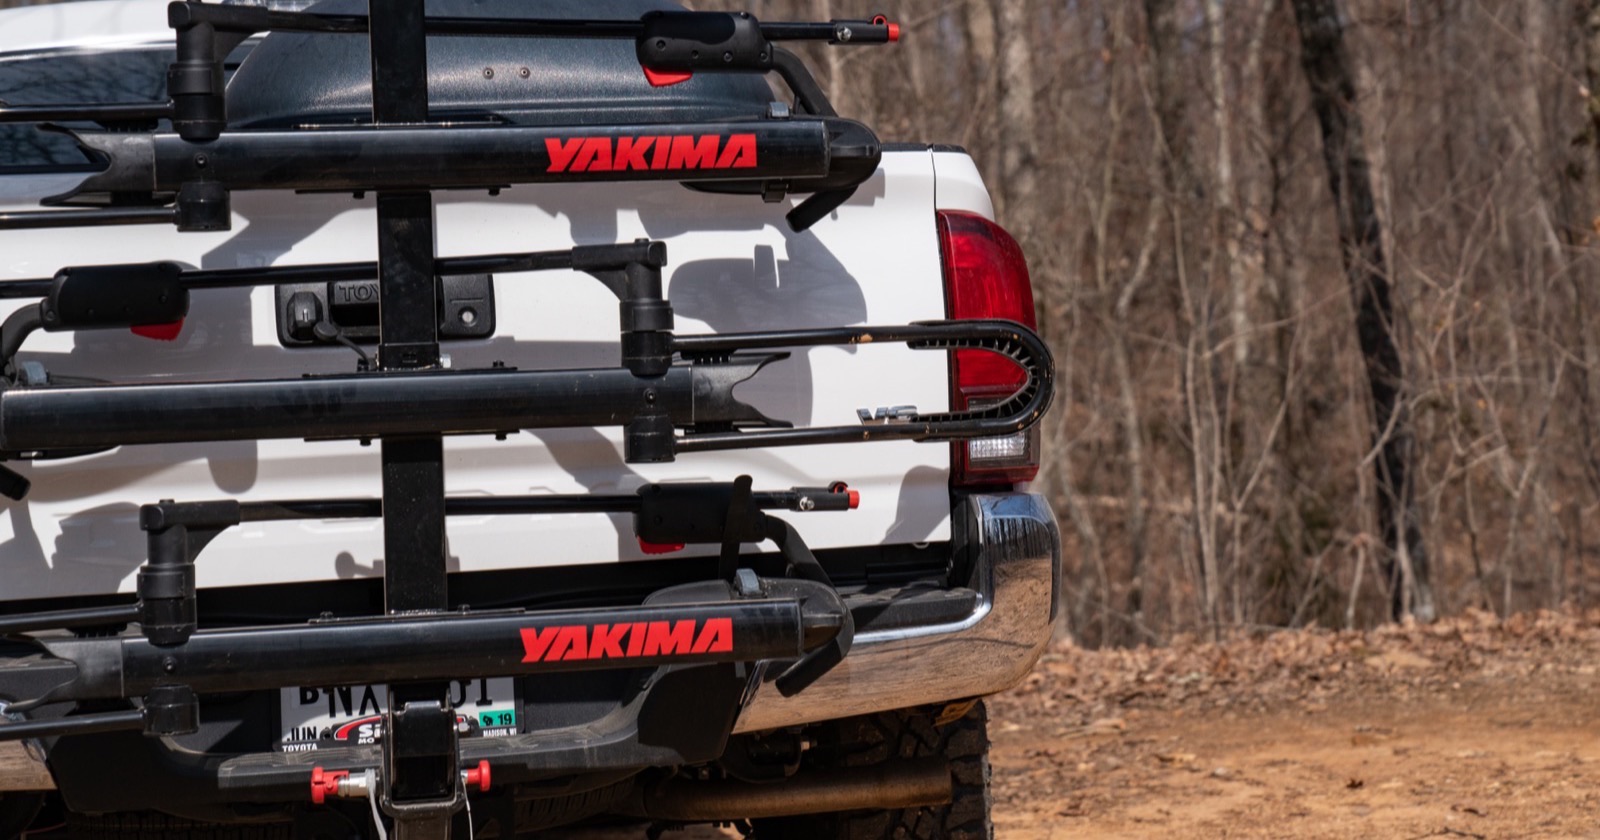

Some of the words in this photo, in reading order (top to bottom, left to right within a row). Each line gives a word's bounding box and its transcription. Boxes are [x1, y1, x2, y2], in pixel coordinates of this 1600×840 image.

[546, 133, 757, 172] YAKIMA
[520, 617, 733, 663] YAKIMA
[498, 713, 513, 725] 19
[282, 743, 318, 752] TOYOTA
